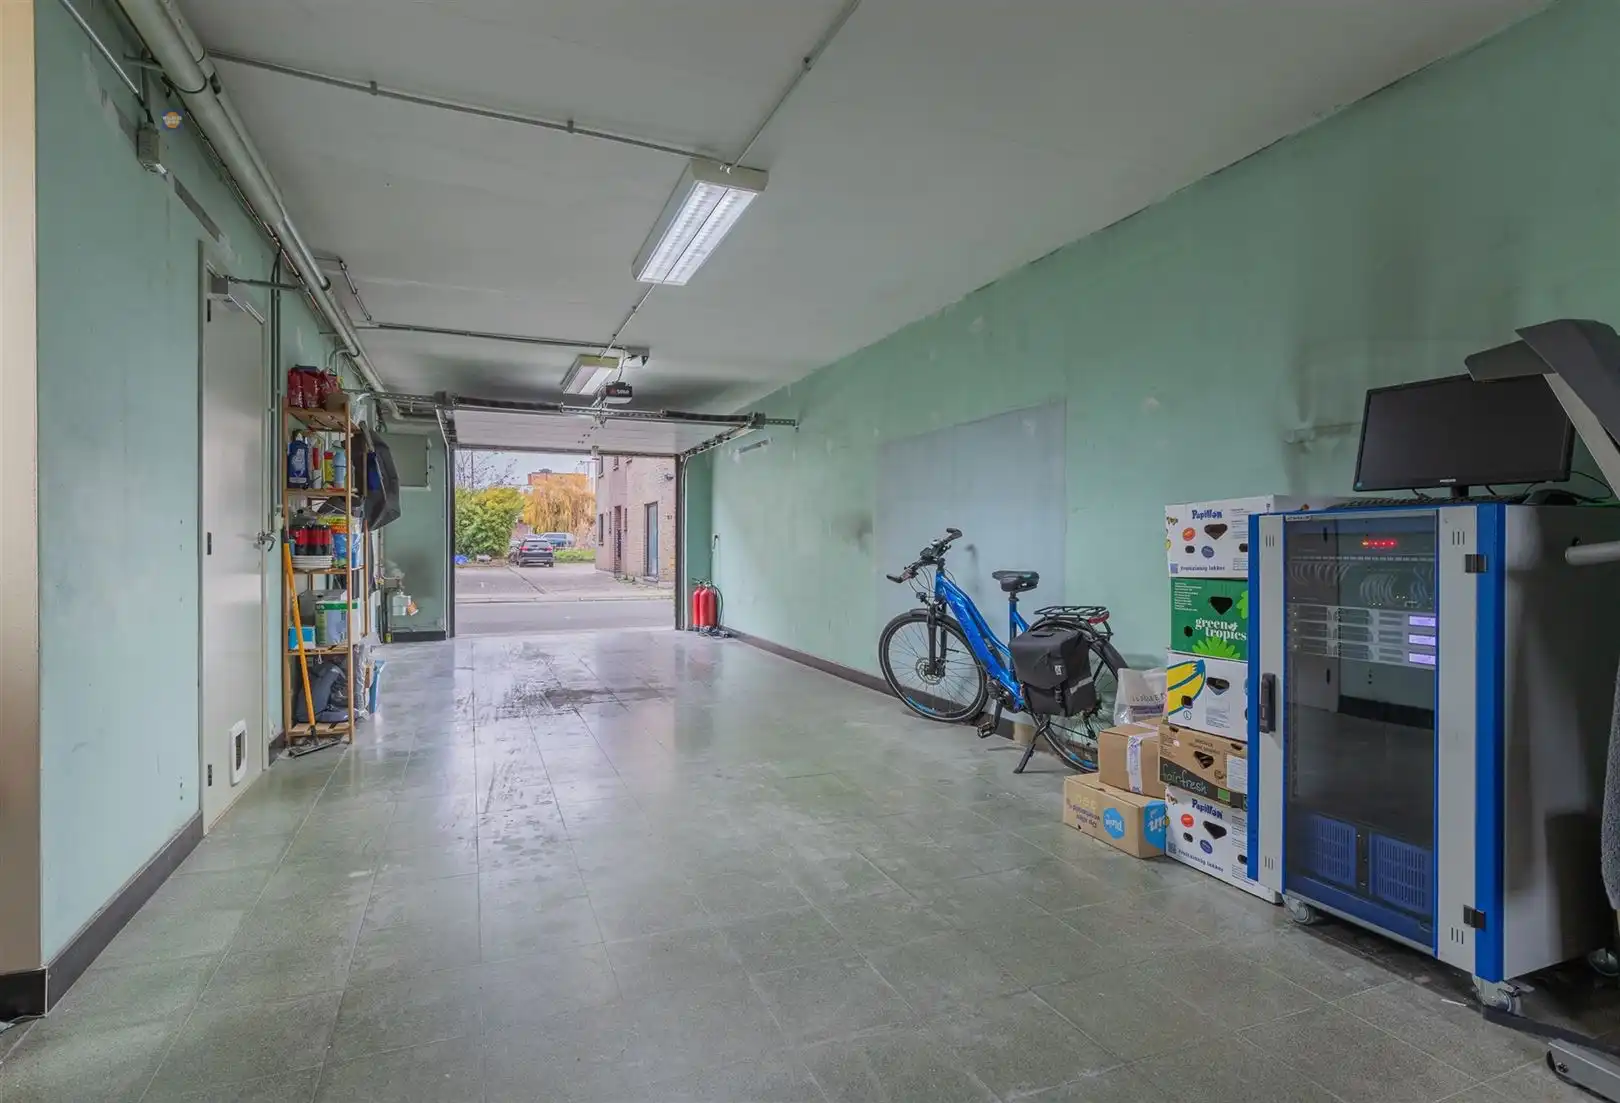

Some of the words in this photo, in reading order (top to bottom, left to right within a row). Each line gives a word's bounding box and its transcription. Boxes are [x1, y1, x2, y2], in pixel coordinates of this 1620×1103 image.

[1191, 509, 1223, 521] Papillon
[1195, 618, 1229, 630] green
[1205, 627, 1247, 641] tropics
[1192, 797, 1223, 820] Papillon
